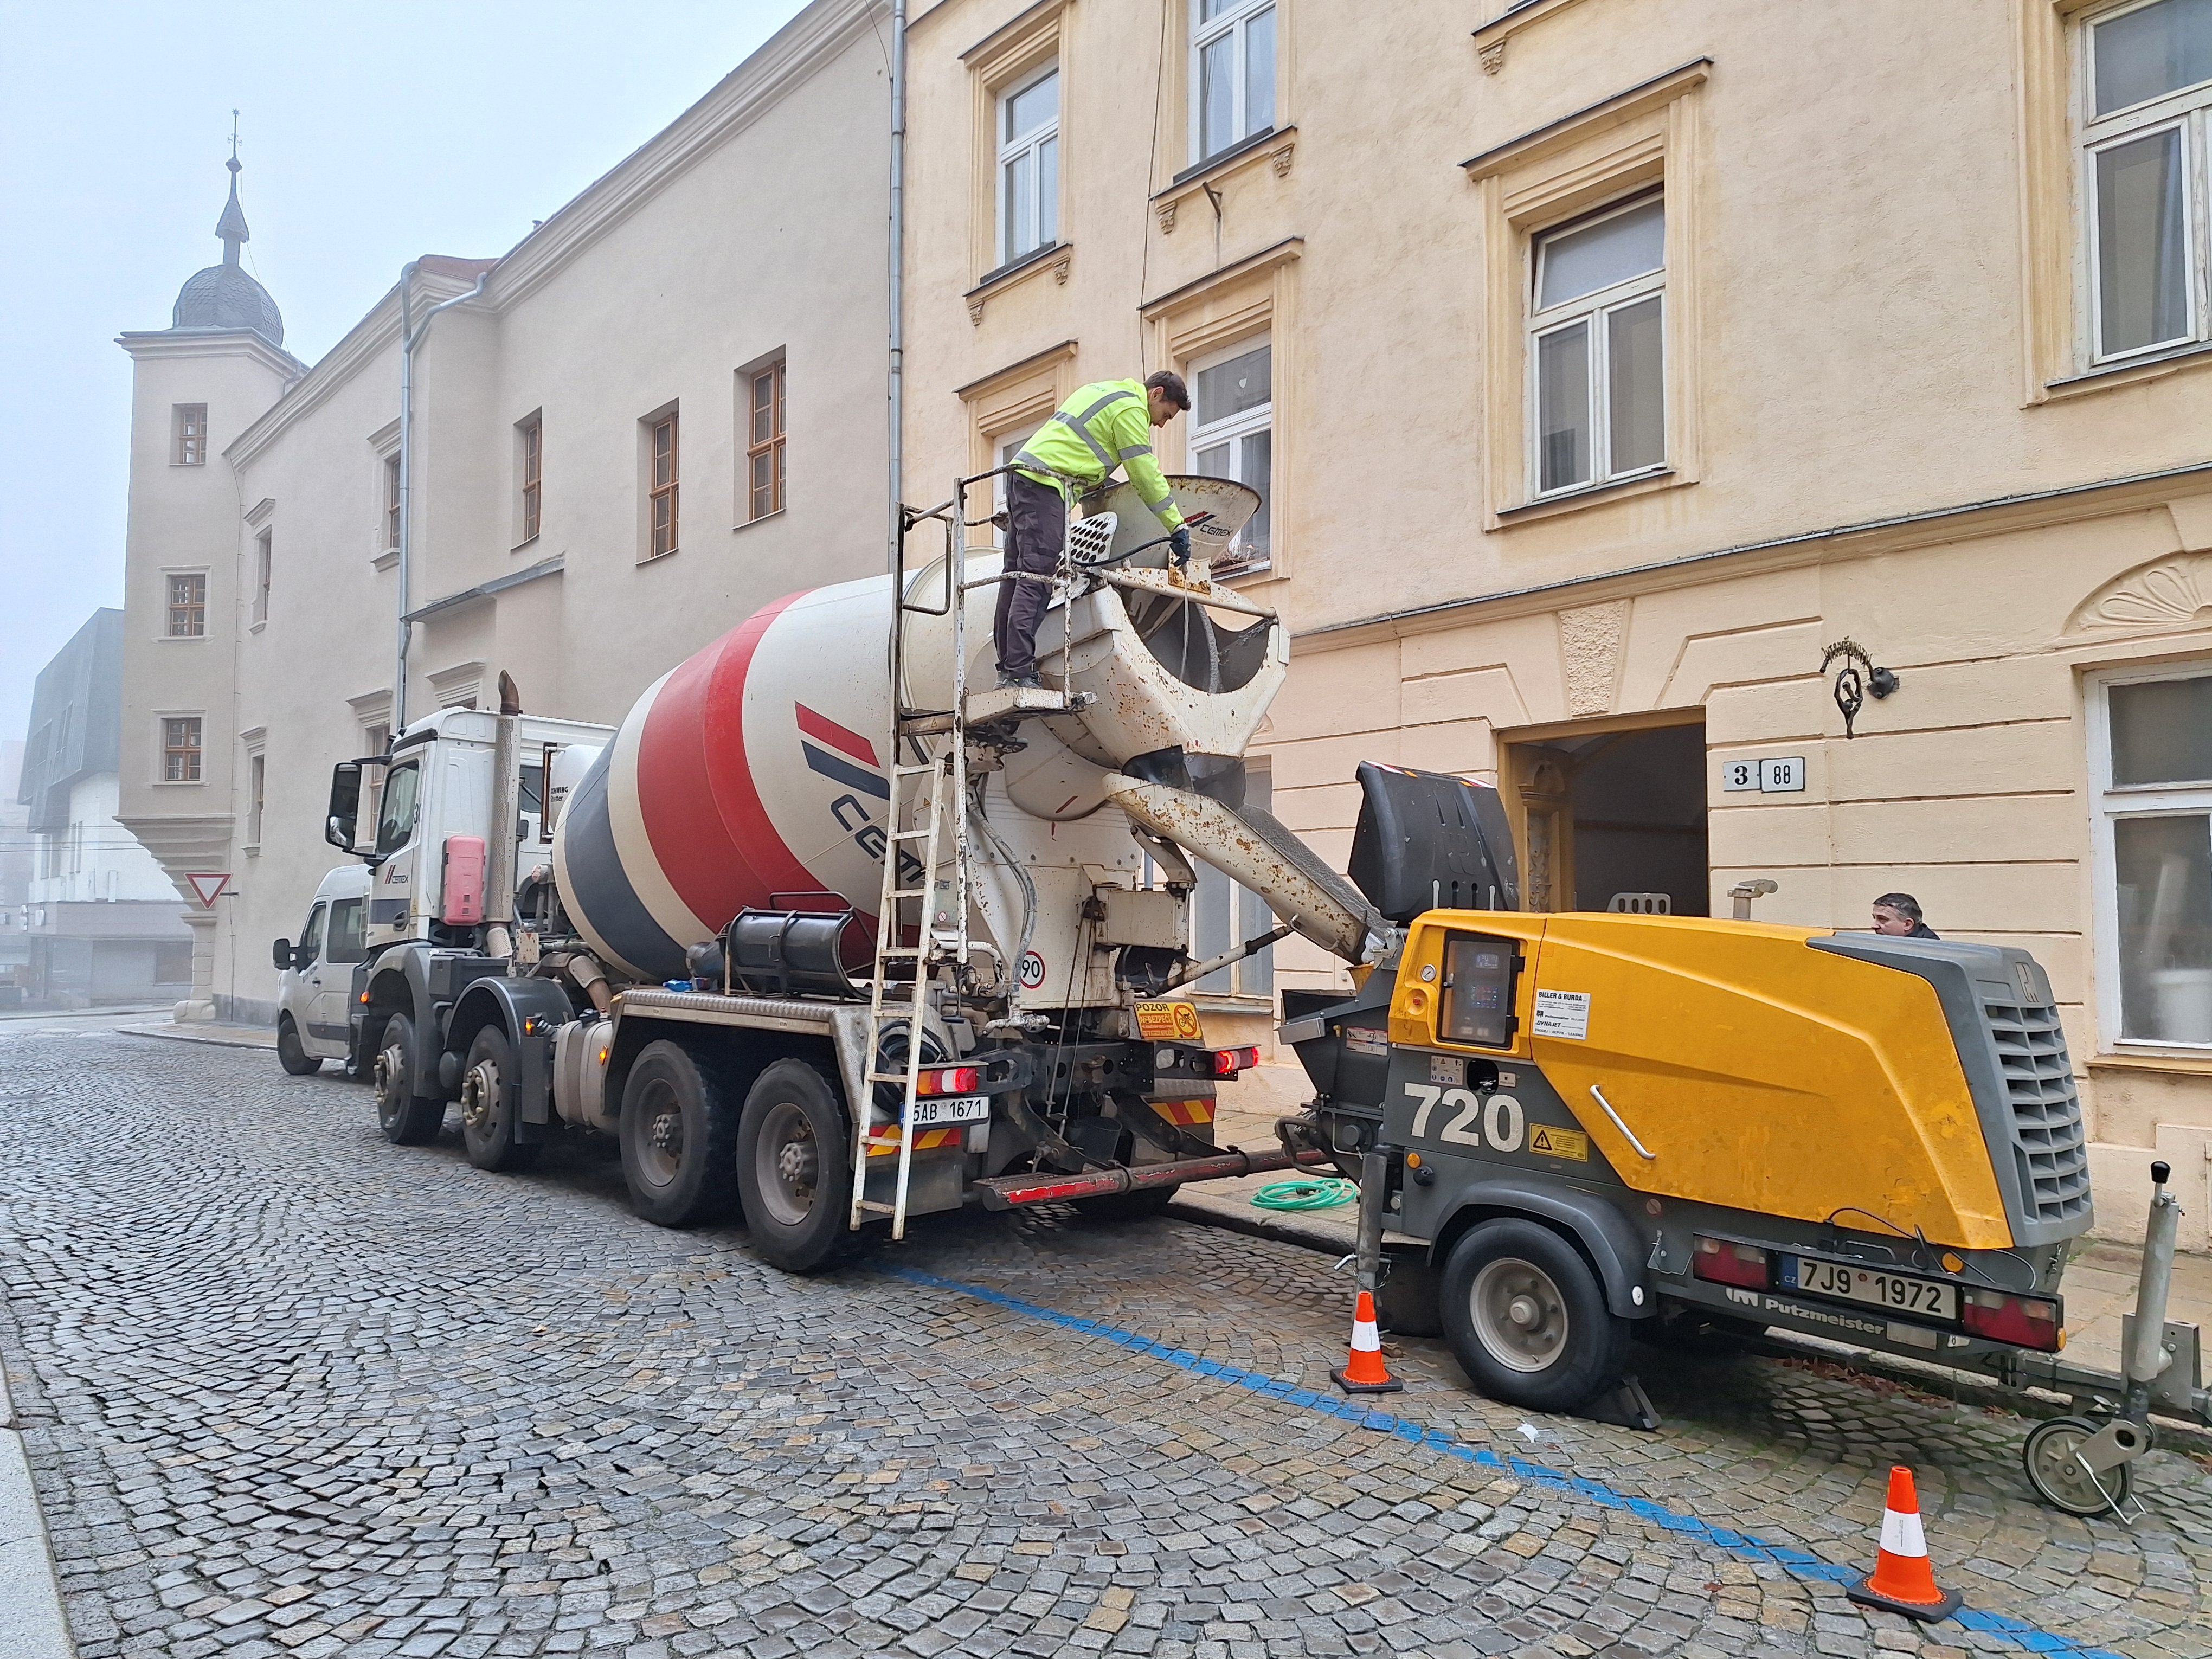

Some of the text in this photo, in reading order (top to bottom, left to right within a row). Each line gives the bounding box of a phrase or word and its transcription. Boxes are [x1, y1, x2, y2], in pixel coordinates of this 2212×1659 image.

[1200, 524, 1233, 537] CEMEX
[1734, 765, 1748, 785] 3
[1774, 764, 1791, 785] 88
[1021, 959, 1040, 978] 90
[1538, 991, 1557, 999] BILLER
[1136, 1004, 1170, 1012] POZOR
[914, 1099, 981, 1122] 5AB 1671
[1404, 1082, 1524, 1152] 720
[1784, 1262, 1942, 1314] CZ 7J9 1972
[1765, 1298, 1885, 1335] Putzmeister
